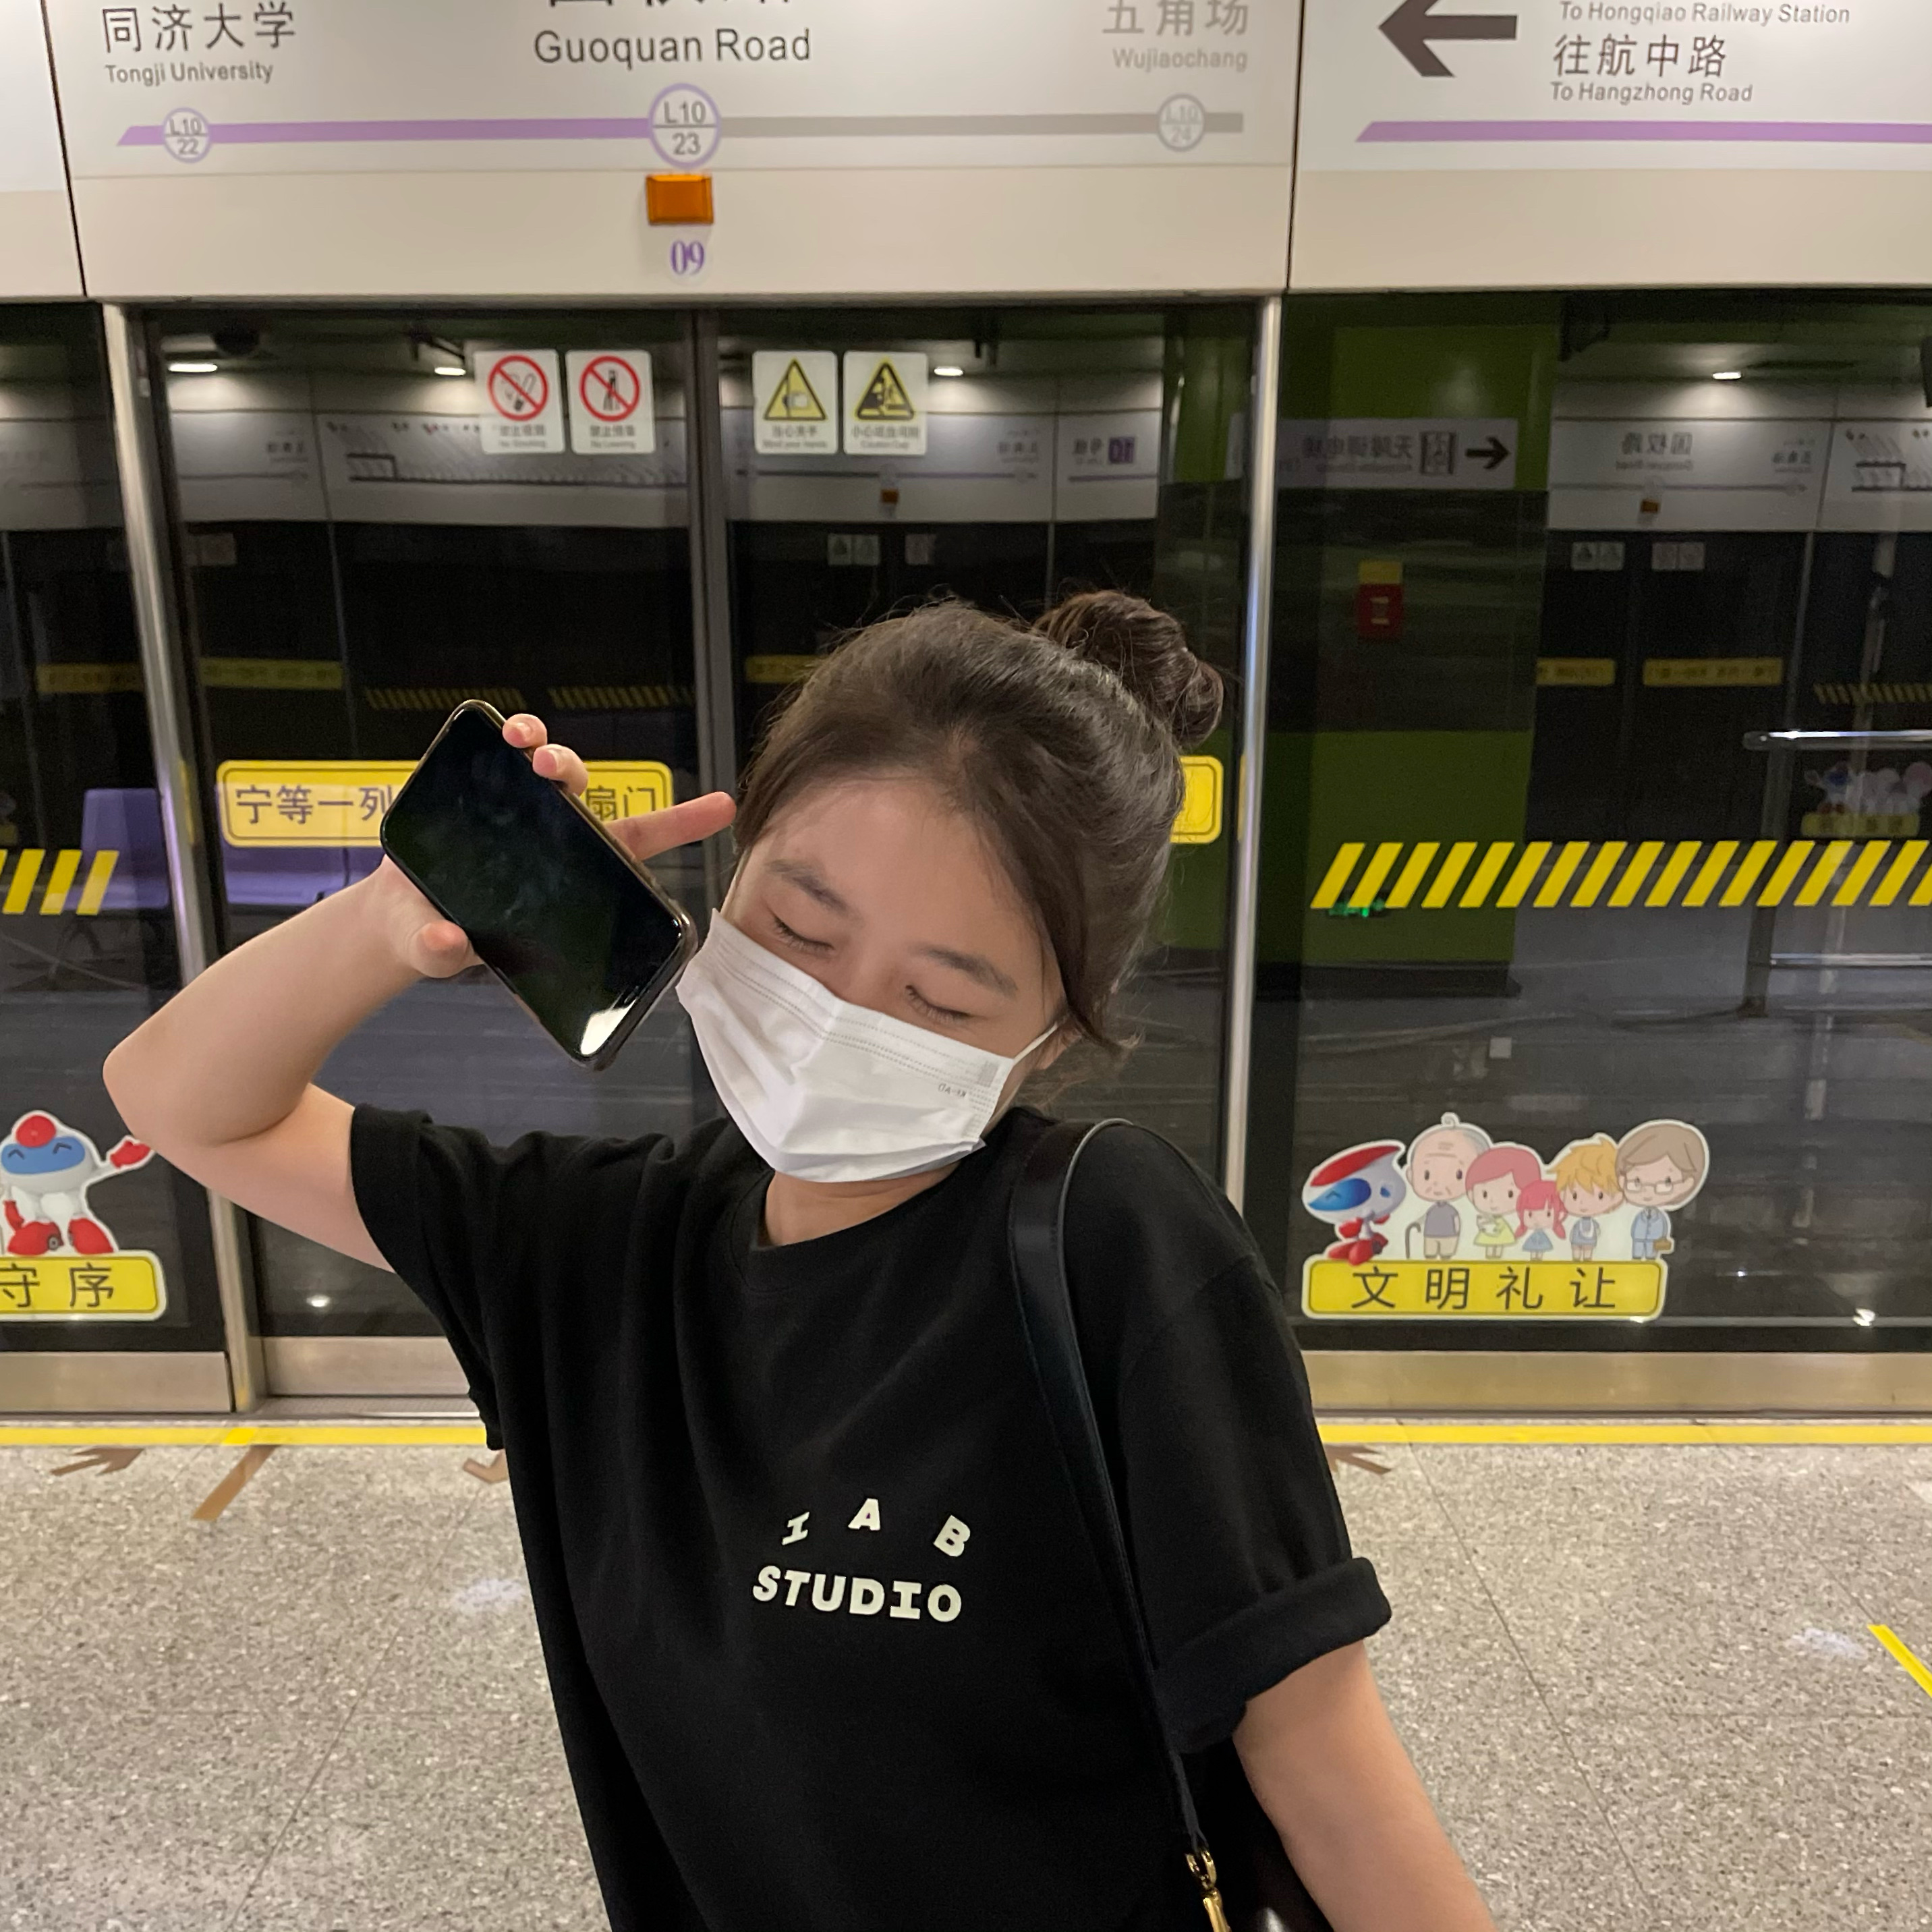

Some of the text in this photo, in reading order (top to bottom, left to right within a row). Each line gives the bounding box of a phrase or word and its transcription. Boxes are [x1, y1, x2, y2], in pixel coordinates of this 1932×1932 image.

[103, 1, 295, 53] 同济大学
[1102, 0, 1249, 36] 五角场
[1560, 2, 1850, 26] To Hongqiao Railway Station
[534, 28, 811, 70] Guoquan Road
[1112, 48, 1248, 73] Wujiaochang
[1553, 34, 1727, 78] 往航中路
[105, 61, 274, 86] Tongji University
[1550, 81, 1754, 105] To Hangzhong Road
[169, 117, 202, 136] L10
[664, 102, 706, 124] L10
[177, 139, 199, 155] 22
[674, 133, 702, 156] 23
[670, 240, 706, 275] 09
[236, 784, 656, 824] 宁等一列 扇门
[0, 1262, 114, 1307] 守序
[1351, 1266, 1616, 1310] 文明礼让
[752, 1565, 962, 1622] STUDIO
